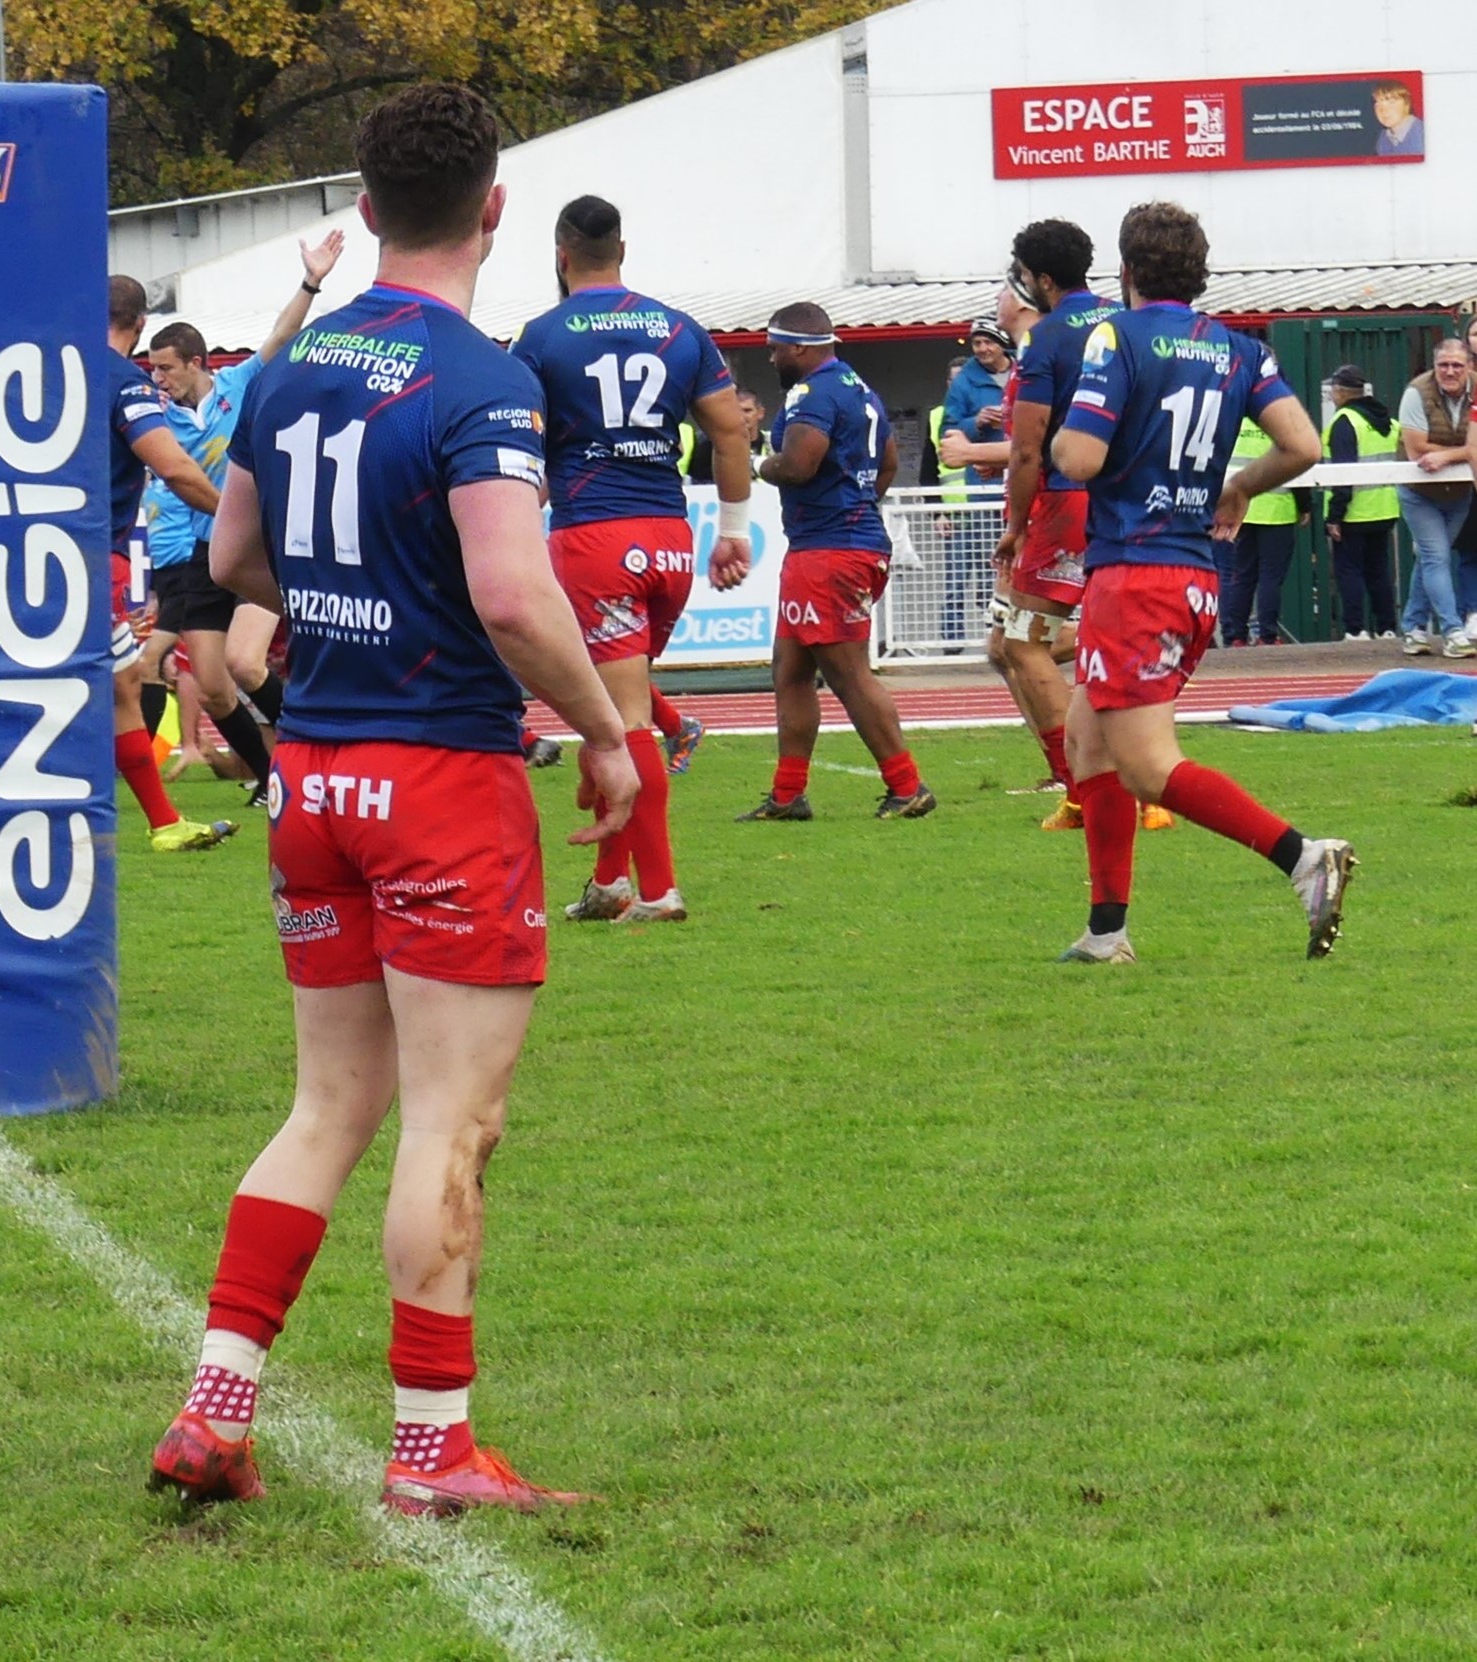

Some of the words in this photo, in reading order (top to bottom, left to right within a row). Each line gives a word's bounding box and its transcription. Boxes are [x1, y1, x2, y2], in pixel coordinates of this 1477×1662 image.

[1023, 96, 1153, 133] ESPACE
[1008, 145, 1084, 165] Vincent
[1093, 139, 1171, 162] BARTHE
[1185, 143, 1226, 158] AUCH
[591, 318, 670, 331] NUTRITION
[314, 332, 424, 362] HERBALIFE
[306, 346, 416, 379] NUTRITION
[584, 352, 667, 429] 12
[510, 418, 532, 429] SUD
[1161, 386, 1223, 472] 14
[275, 411, 366, 566] 11
[655, 550, 694, 574] SNT
[288, 588, 392, 632] PIZZORNO
[781, 600, 820, 625] OA
[669, 608, 764, 645] Ouest
[301, 773, 393, 821] STH
[276, 905, 338, 934] BRAN
[426, 917, 474, 935] énergie
